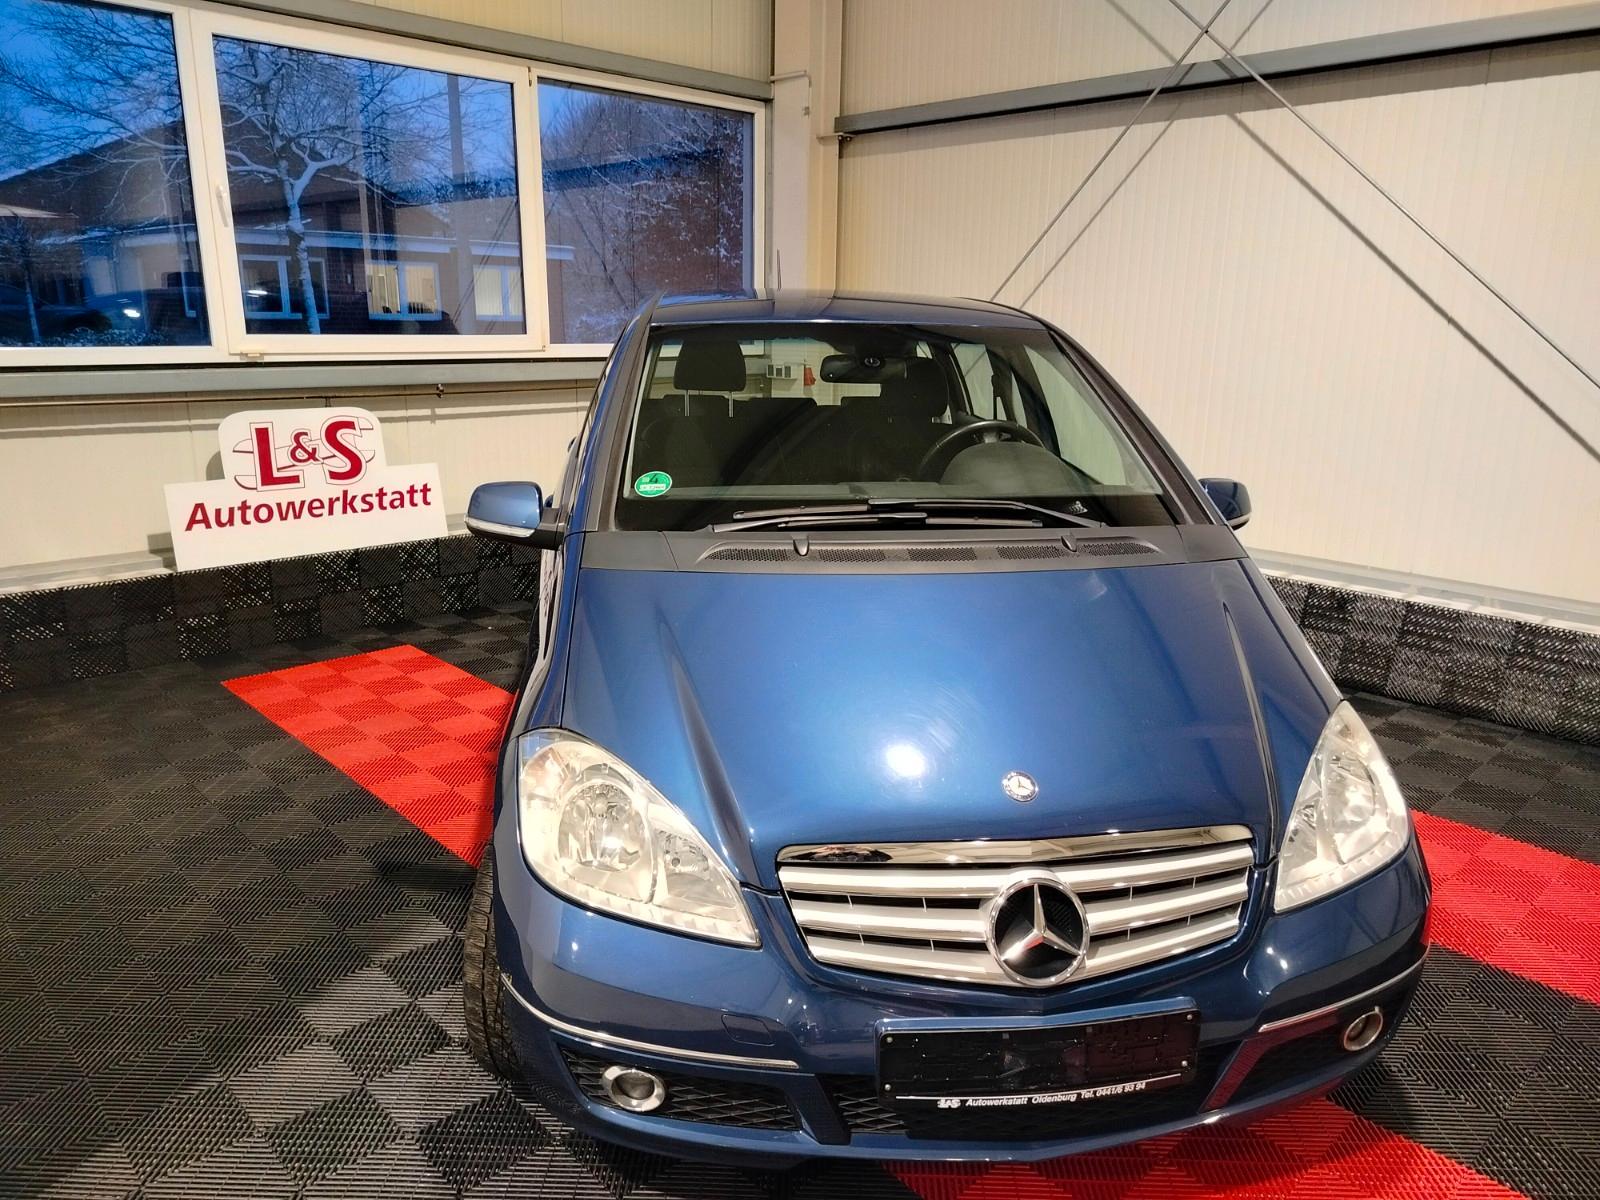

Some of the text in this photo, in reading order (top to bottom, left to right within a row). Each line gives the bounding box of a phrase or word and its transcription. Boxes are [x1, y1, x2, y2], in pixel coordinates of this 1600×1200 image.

[252, 417, 365, 489] L&S
[185, 483, 432, 532] Autowerkstatt
[965, 1097, 1028, 1106] Autowerkstatt
[1031, 1094, 1077, 1104] Oldenburg
[1080, 1090, 1094, 1099] Tel.
